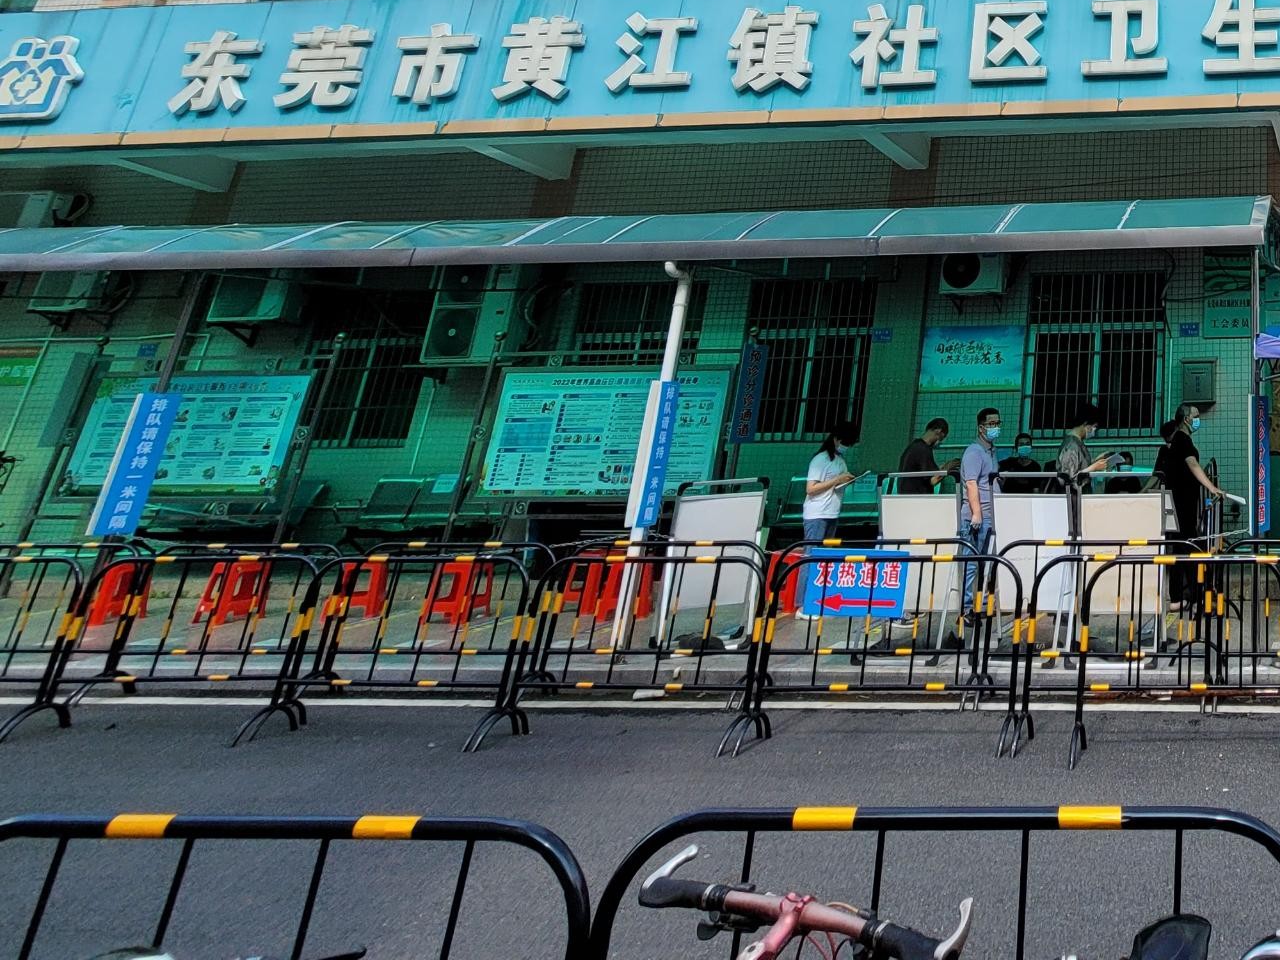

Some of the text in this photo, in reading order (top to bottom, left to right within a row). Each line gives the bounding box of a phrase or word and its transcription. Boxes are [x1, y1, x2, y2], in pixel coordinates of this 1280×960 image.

[107, 398, 169, 530] 排队请保持一米间隔
[814, 559, 902, 589] 发热通道
